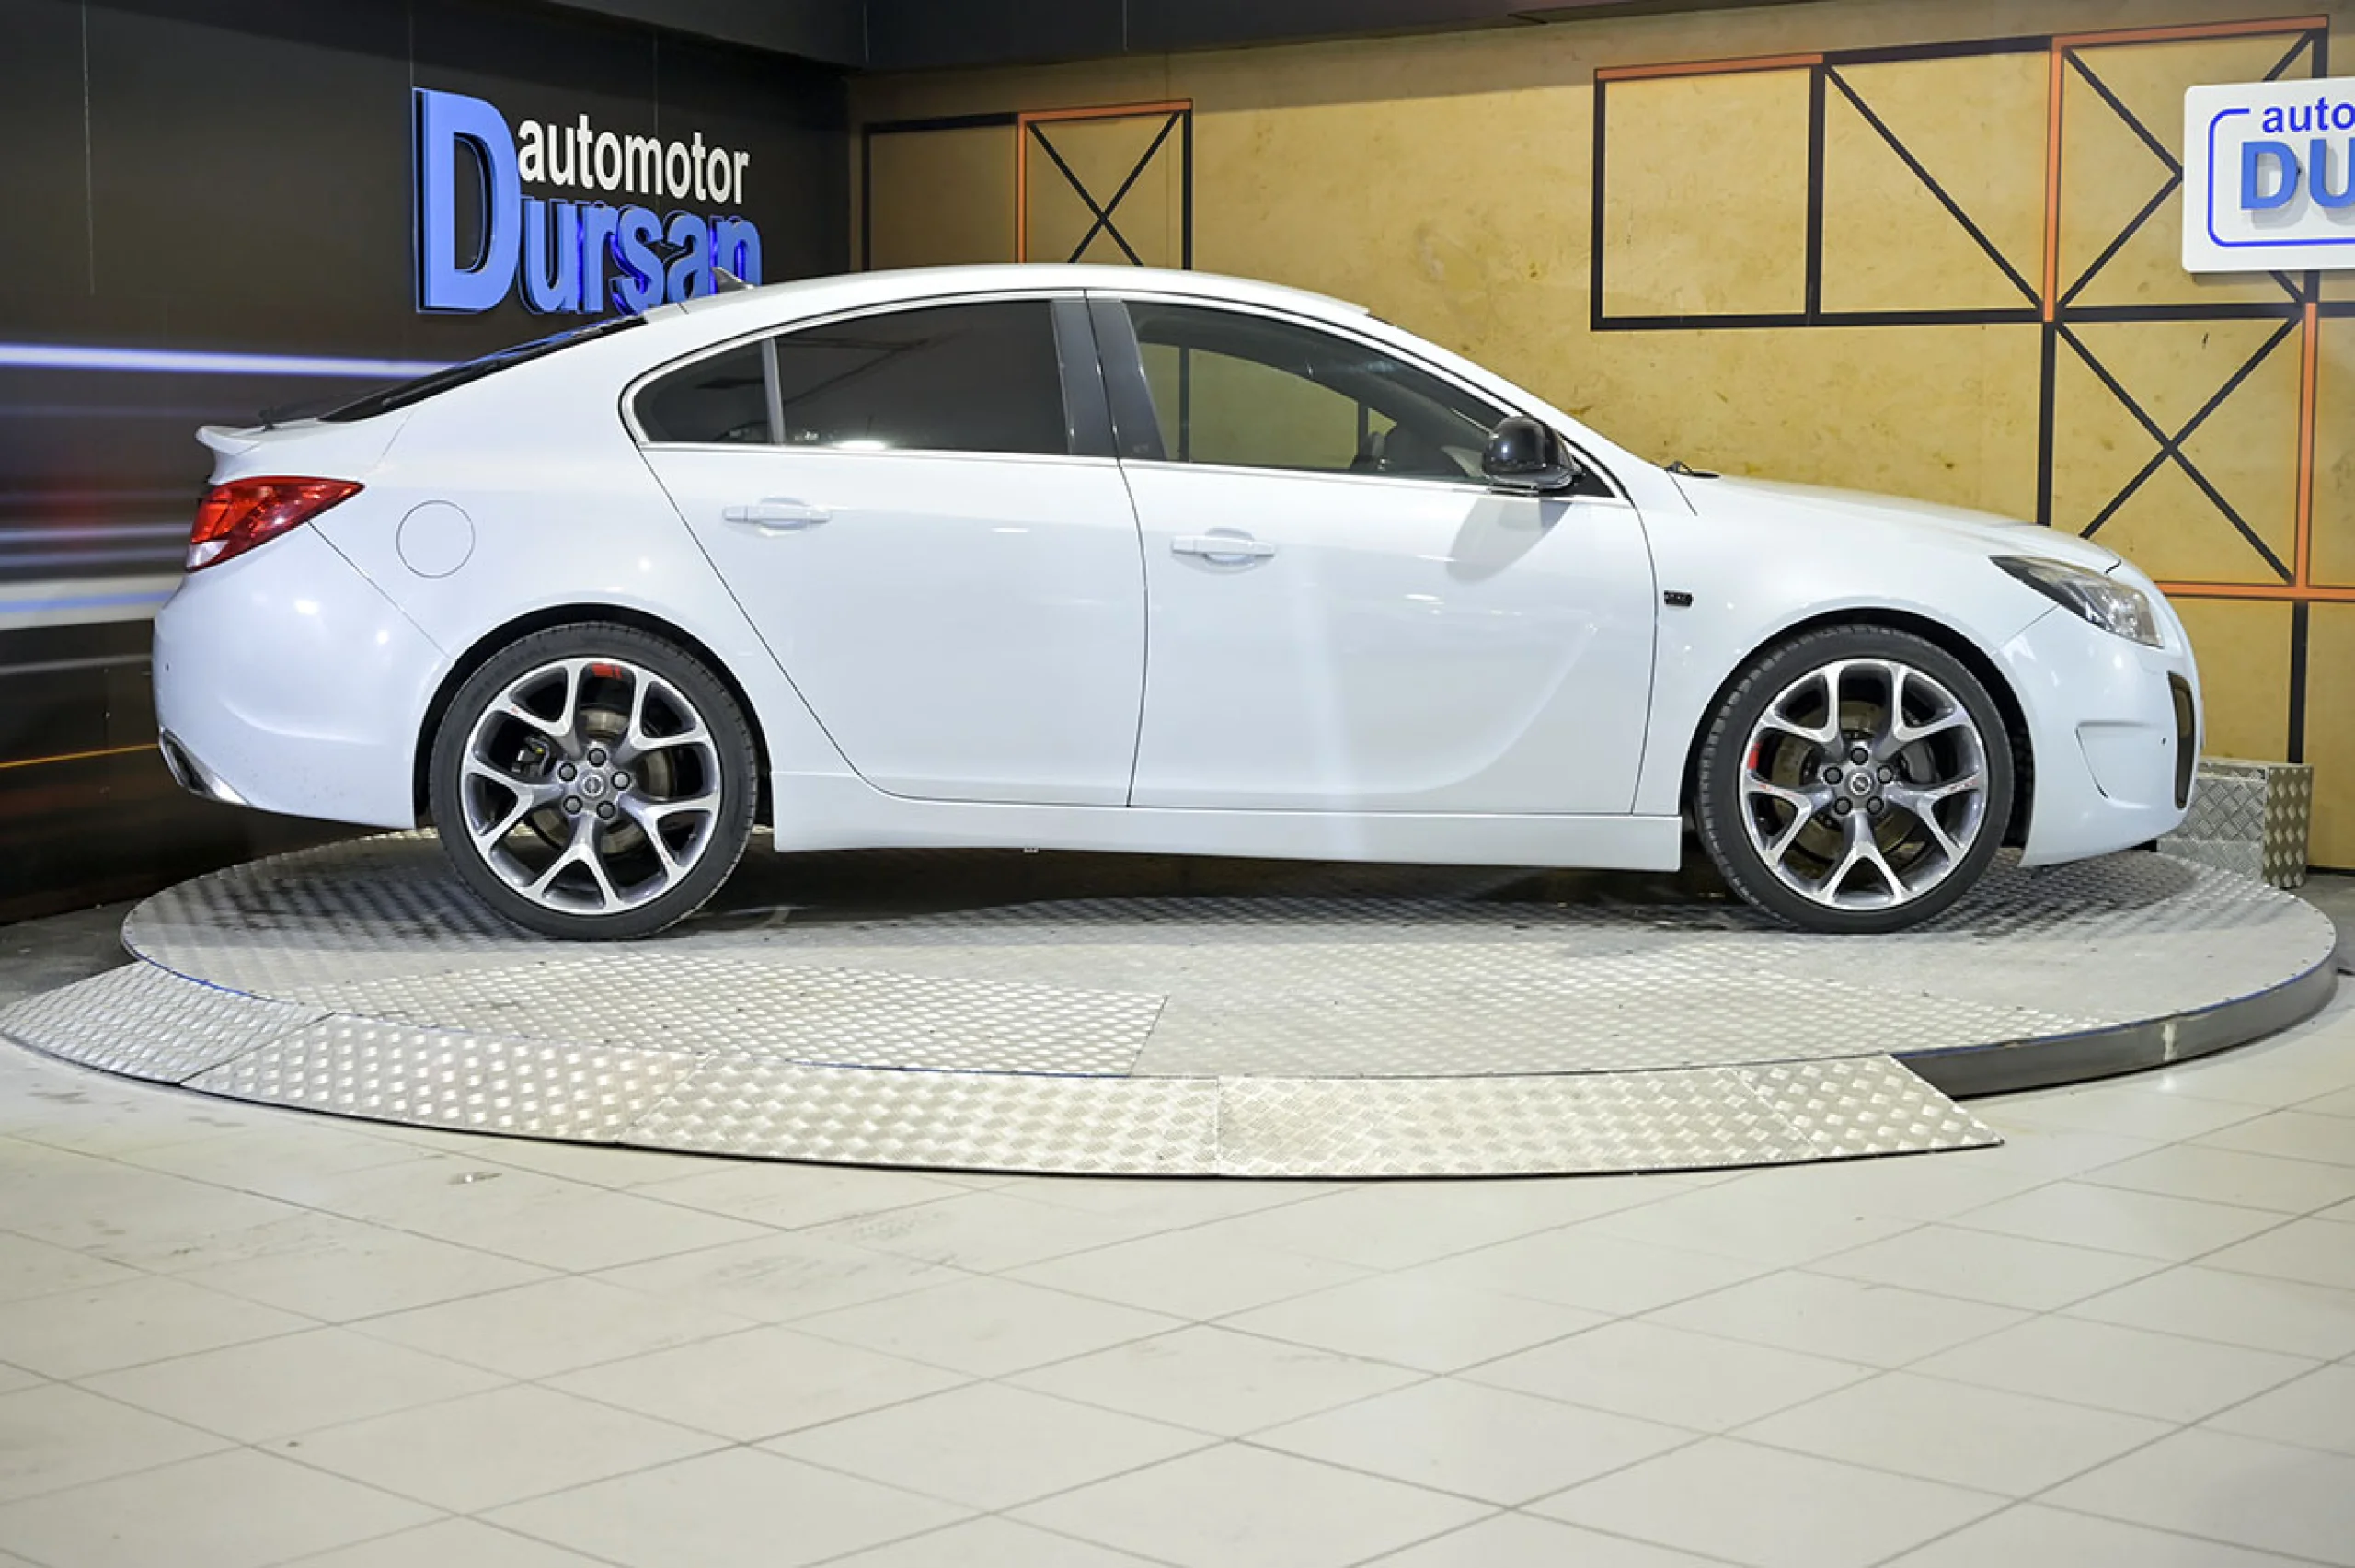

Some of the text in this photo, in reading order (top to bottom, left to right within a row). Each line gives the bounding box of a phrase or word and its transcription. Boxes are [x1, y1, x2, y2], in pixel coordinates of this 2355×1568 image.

[2262, 96, 2355, 132] auto
[518, 113, 750, 204] automotor
[2240, 136, 2355, 211] DU
[412, 86, 763, 316] Dursan
